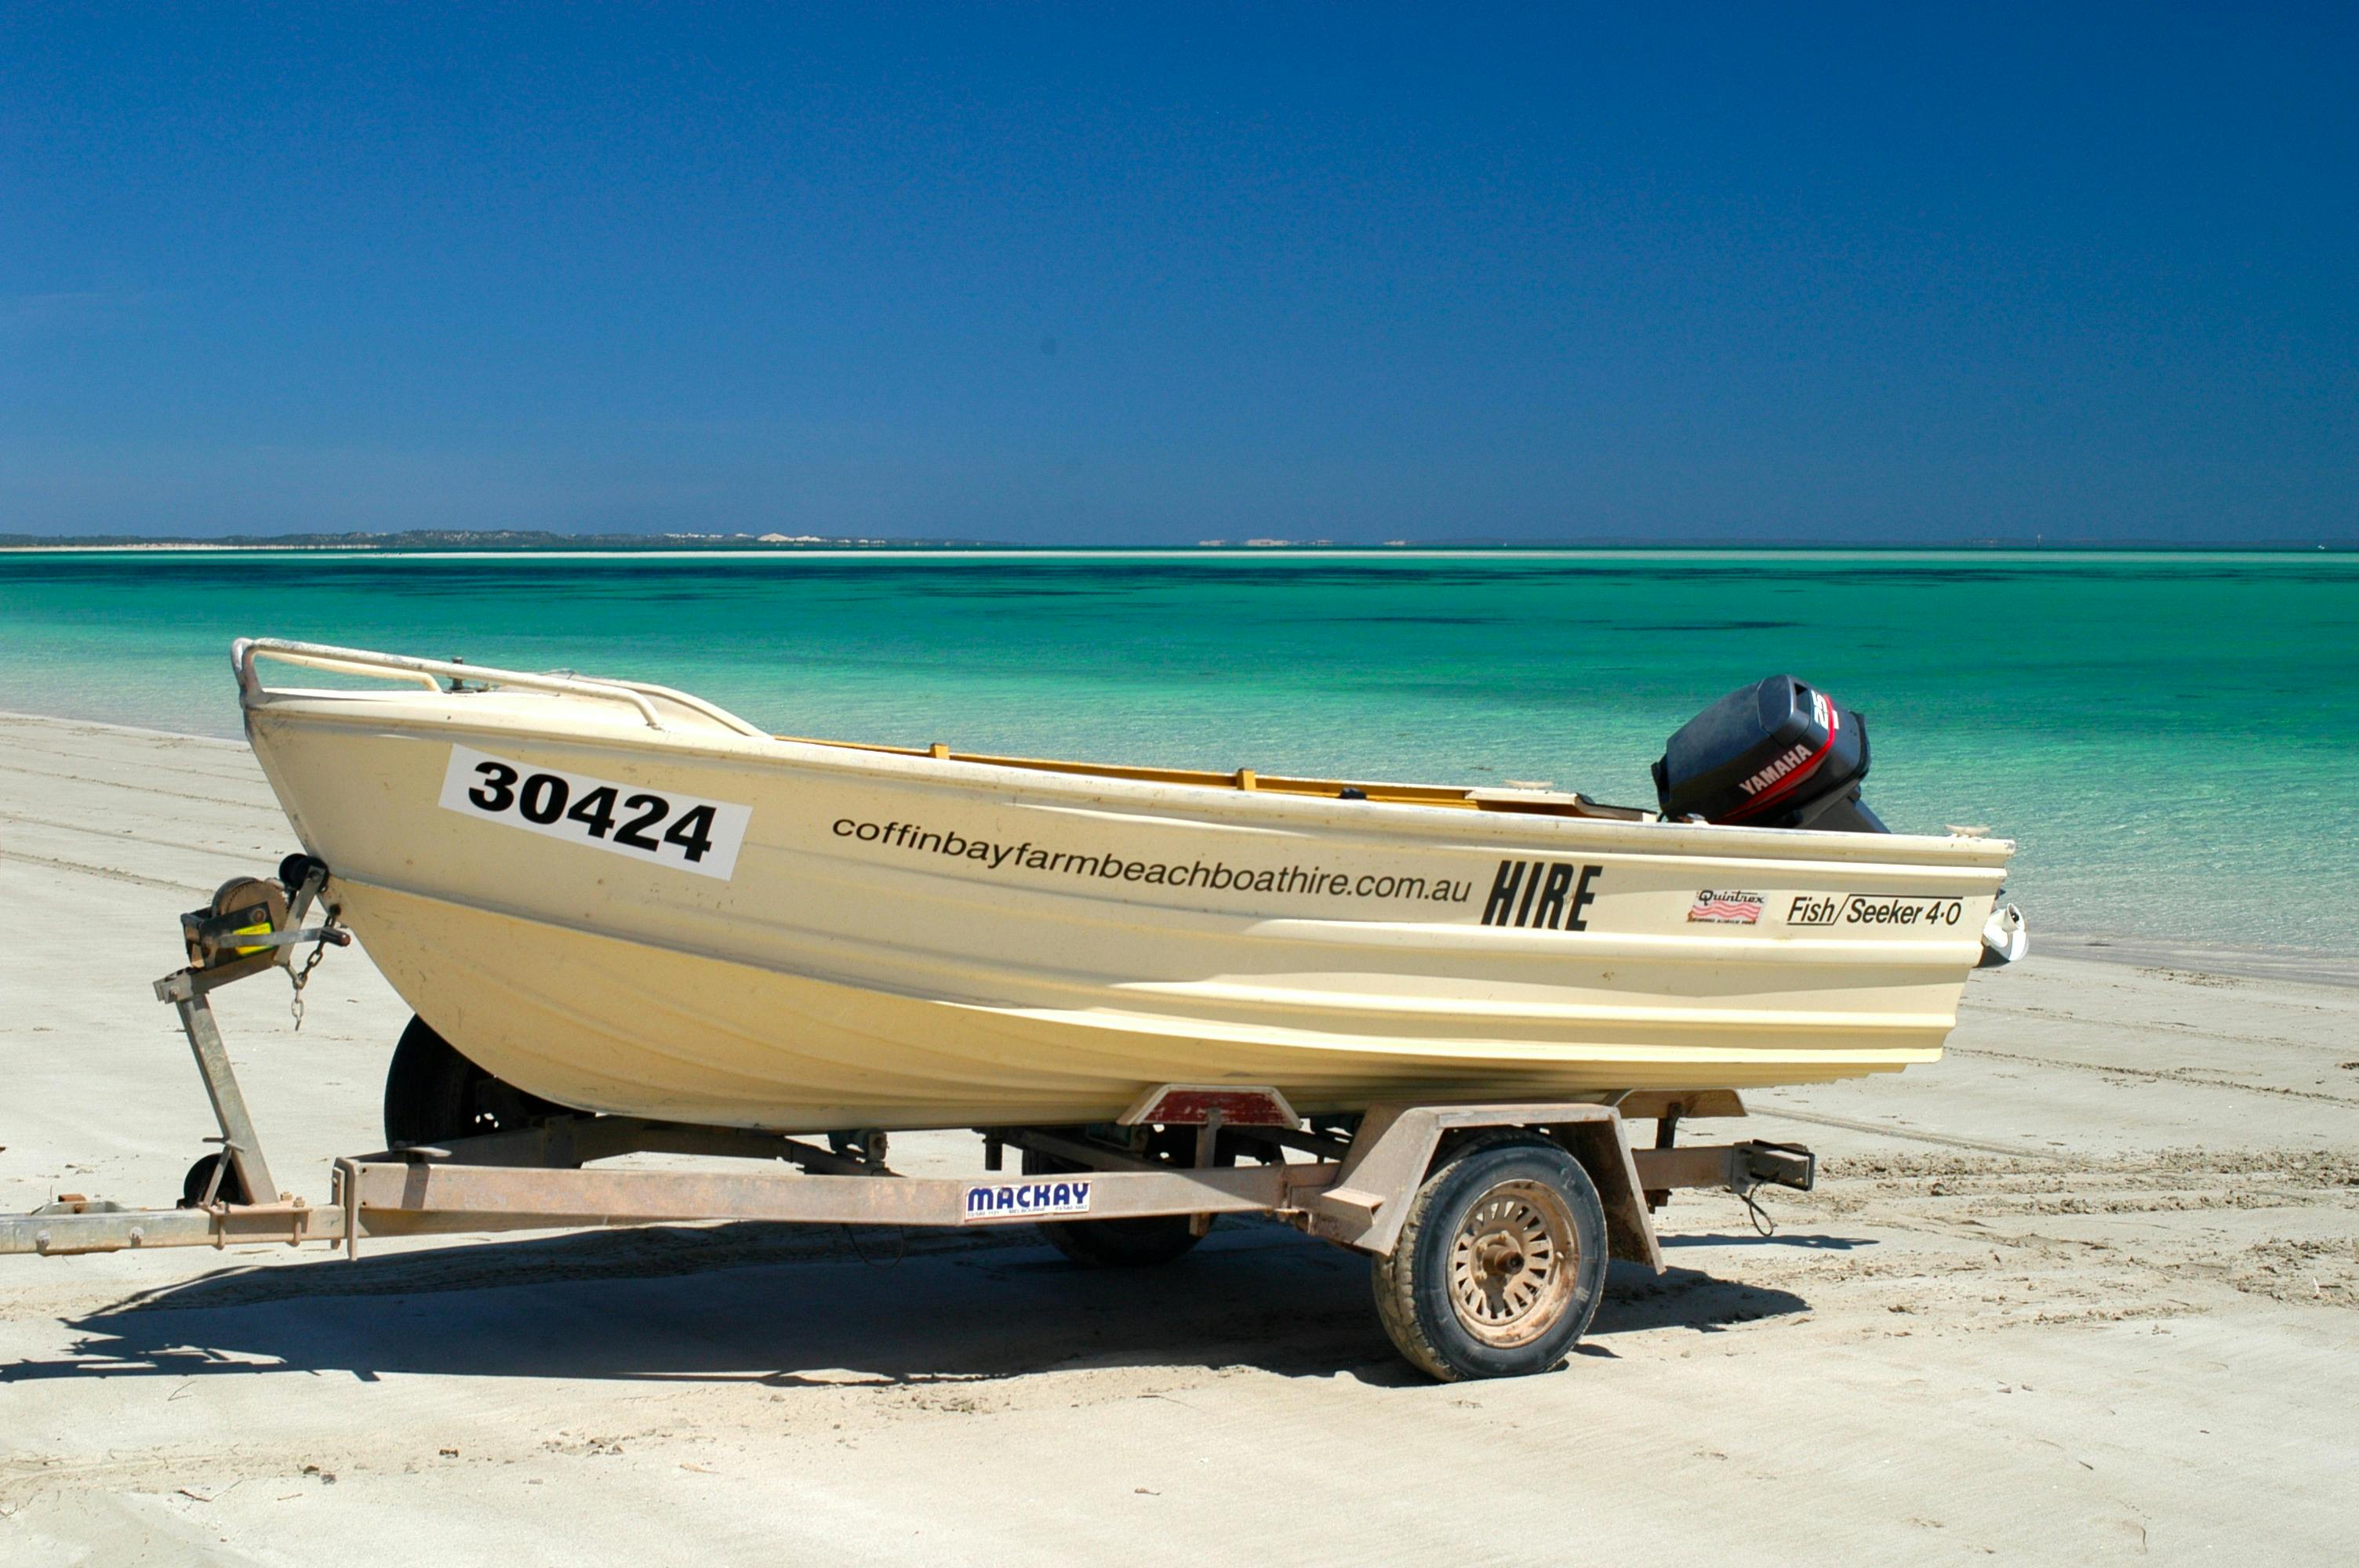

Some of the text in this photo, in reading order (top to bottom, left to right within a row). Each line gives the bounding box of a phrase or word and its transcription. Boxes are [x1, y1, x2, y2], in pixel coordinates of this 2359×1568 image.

[1739, 743, 1813, 796] YAMAHA
[468, 760, 717, 863] 30424
[832, 818, 1472, 902] coffinbayfarmbeachboathire.com.au
[1481, 859, 1604, 931] HIRE
[1698, 890, 1765, 906] Quintrex
[1787, 896, 1835, 923] Fish
[1846, 898, 1923, 925] Seeker
[968, 1182, 1089, 1211] MACKAY
